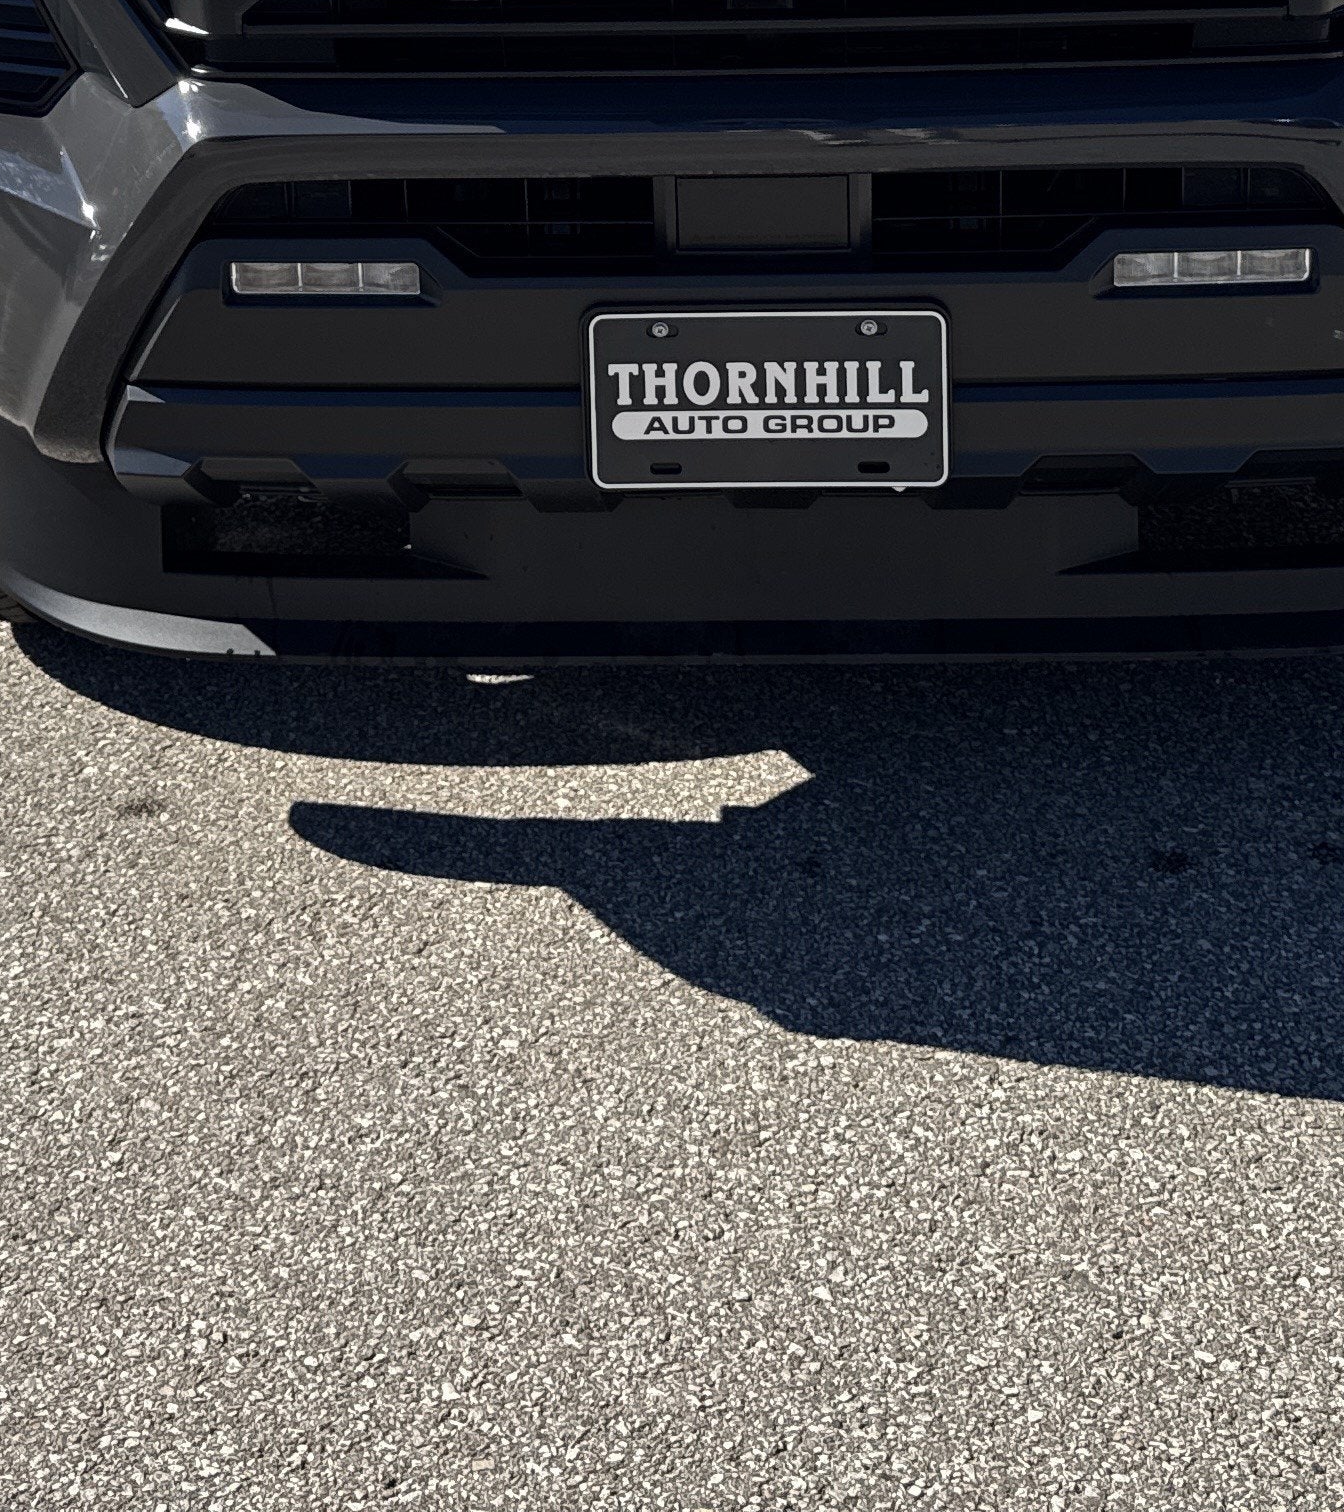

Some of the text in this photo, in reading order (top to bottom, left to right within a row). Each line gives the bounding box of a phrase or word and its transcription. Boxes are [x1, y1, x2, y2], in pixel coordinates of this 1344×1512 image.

[607, 360, 929, 405] THORNHILL
[644, 414, 895, 435] AUTO GROUP
